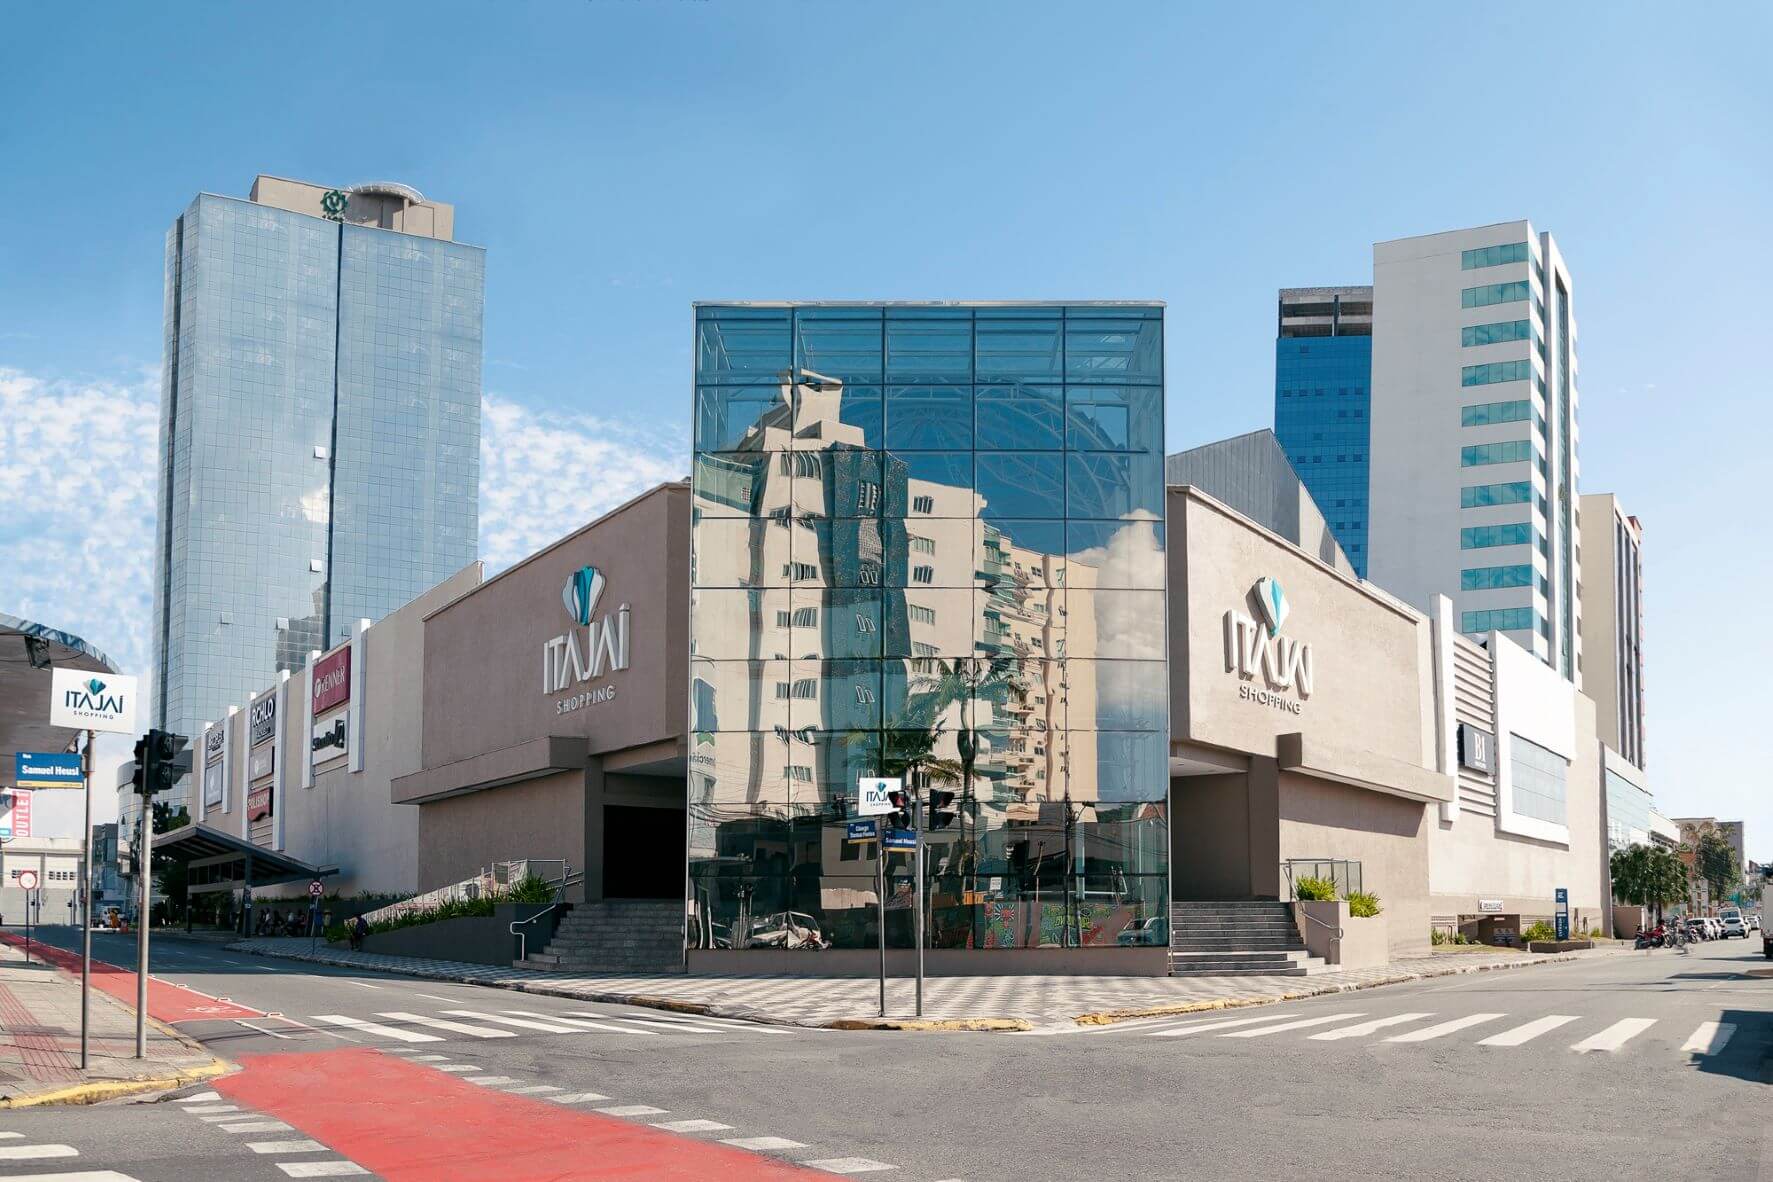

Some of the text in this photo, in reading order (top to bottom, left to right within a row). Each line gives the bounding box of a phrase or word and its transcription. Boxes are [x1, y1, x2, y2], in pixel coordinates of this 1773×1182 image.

[556, 684, 617, 715] SHOPPING
[1238, 684, 1303, 715] SHOPPING
[73, 710, 114, 720] SHOPPING
[21, 765, 54, 775] Samuel
